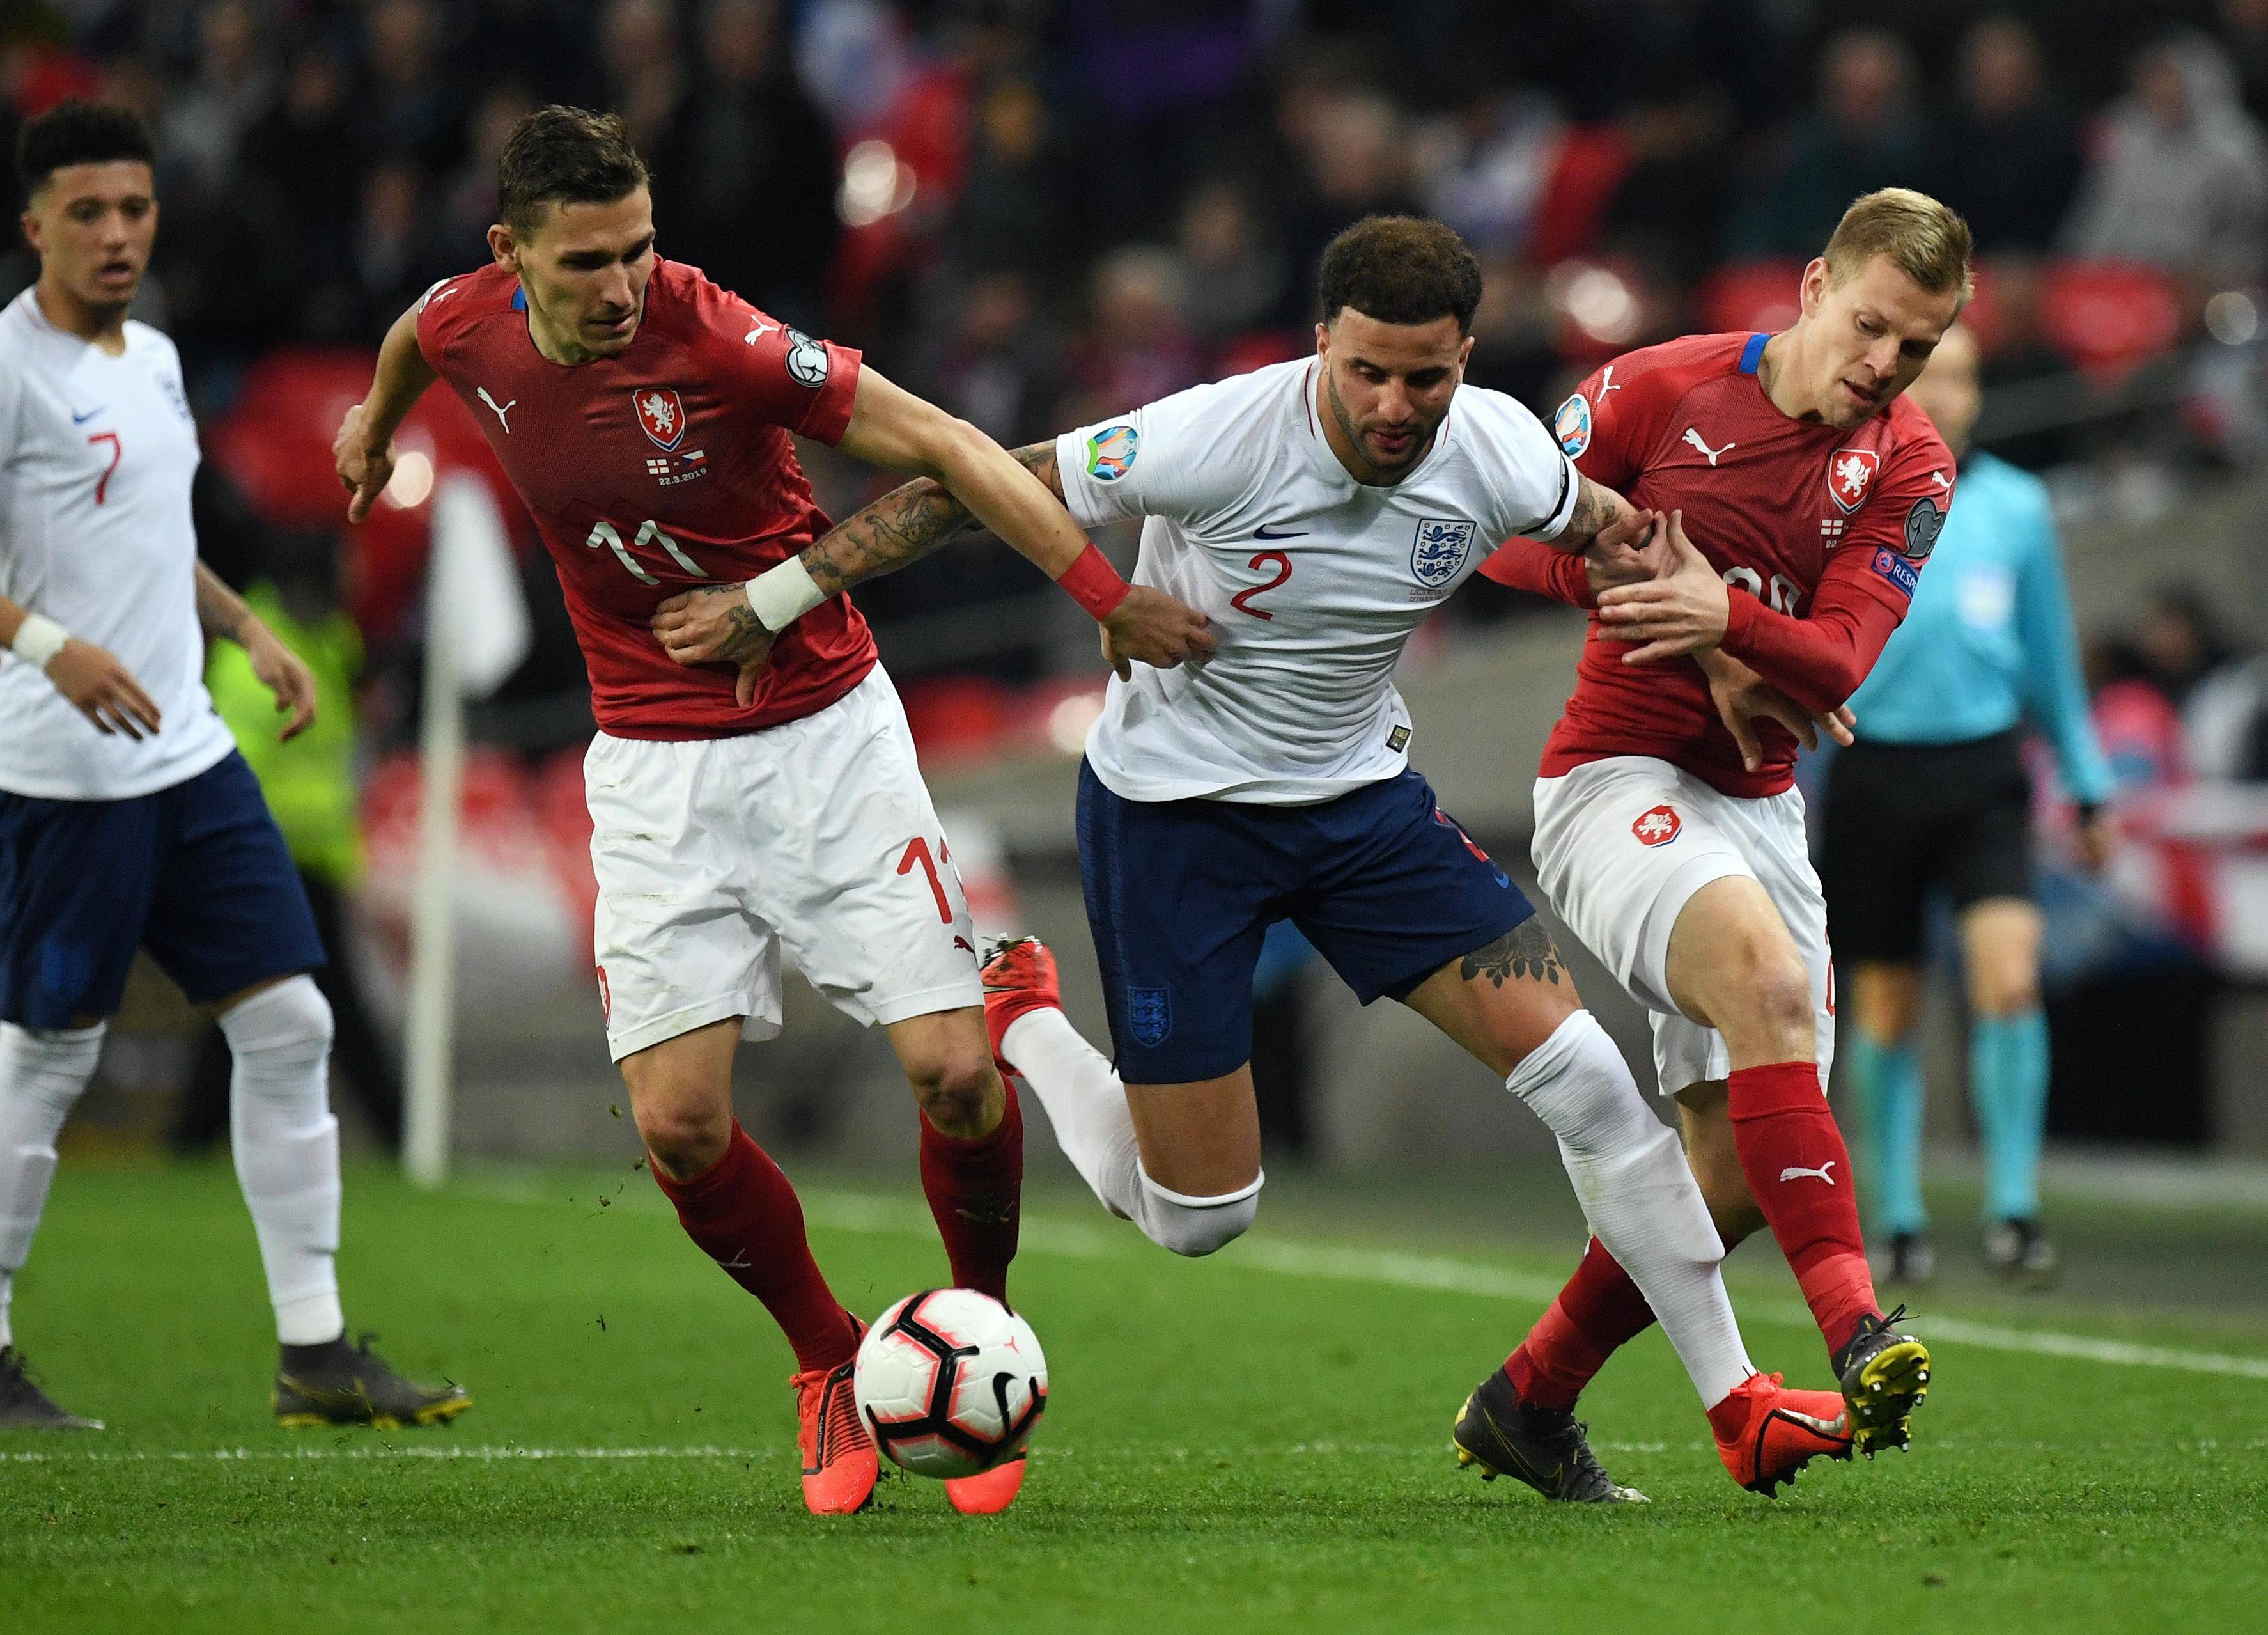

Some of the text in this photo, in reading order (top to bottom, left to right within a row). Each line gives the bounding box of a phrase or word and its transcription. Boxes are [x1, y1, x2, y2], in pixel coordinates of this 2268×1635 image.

[88, 432, 121, 505] 7
[658, 467, 707, 486] 22.3.2019
[586, 519, 709, 586] 11
[1230, 550, 1293, 622] 2
[1893, 564, 1917, 594] RESP
[897, 836, 965, 925] 1
